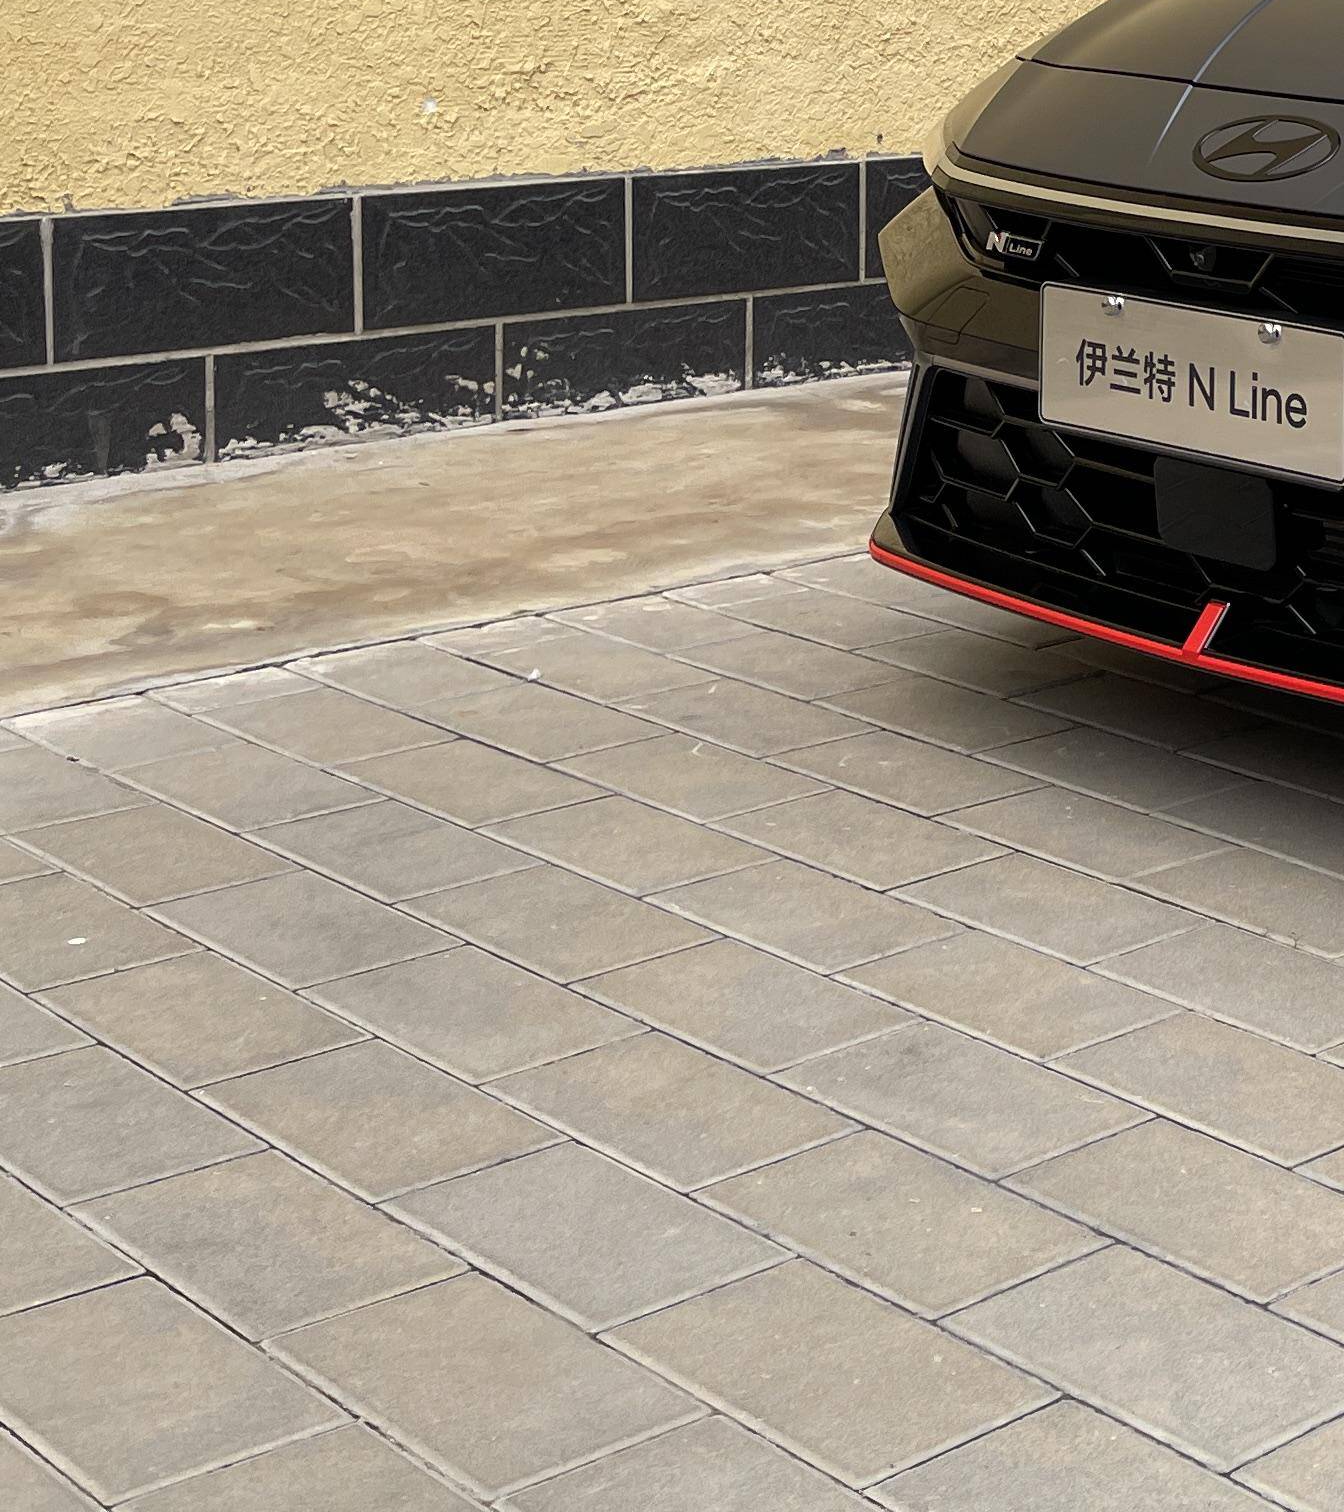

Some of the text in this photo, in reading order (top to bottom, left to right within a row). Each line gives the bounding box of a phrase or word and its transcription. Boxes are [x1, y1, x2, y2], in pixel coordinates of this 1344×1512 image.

[986, 231, 1033, 257] N Line
[1076, 338, 1307, 429] 伊兰特 N Line
